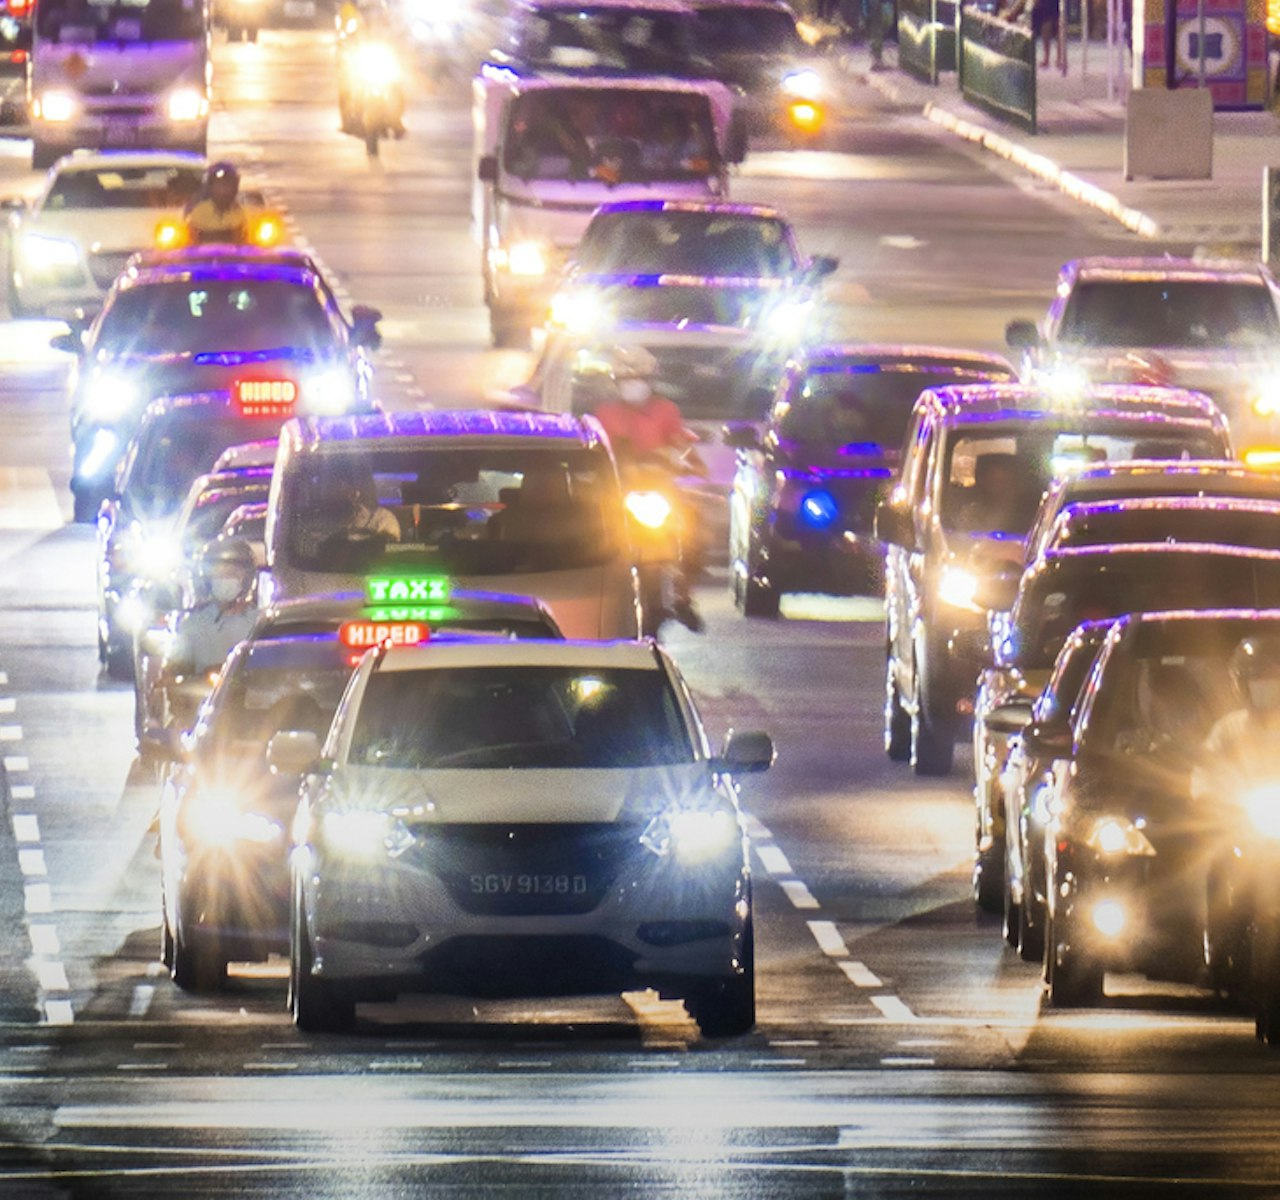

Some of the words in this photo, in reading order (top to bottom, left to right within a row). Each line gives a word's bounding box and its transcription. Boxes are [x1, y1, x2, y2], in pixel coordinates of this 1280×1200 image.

[240, 381, 296, 403] HIRED
[368, 580, 447, 600] TAXI
[347, 624, 420, 646] HIRED
